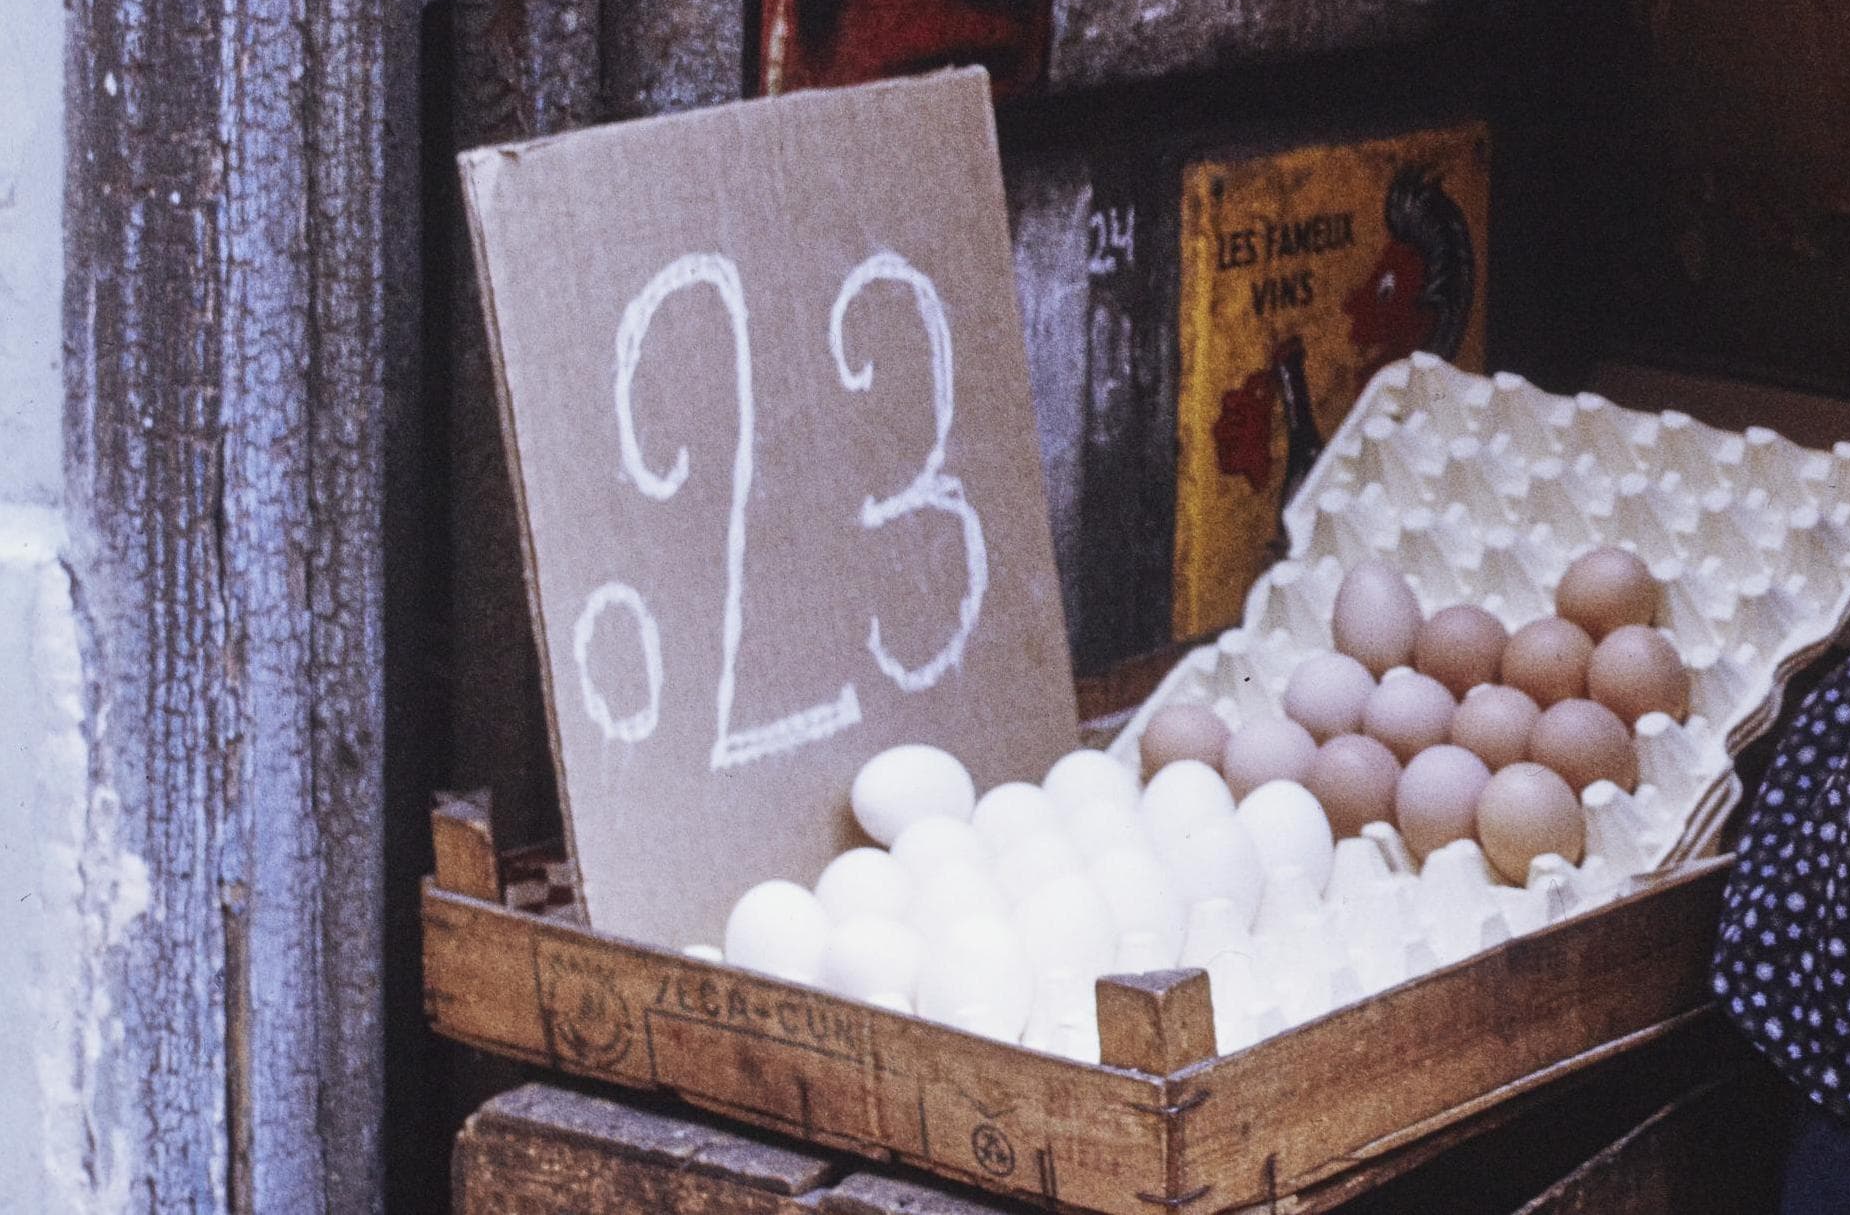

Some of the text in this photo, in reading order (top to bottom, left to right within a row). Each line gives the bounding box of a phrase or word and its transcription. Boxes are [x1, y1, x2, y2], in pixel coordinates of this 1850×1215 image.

[1217, 212, 1357, 271] LES FAMEUX
[1250, 269, 1315, 316] VINS
